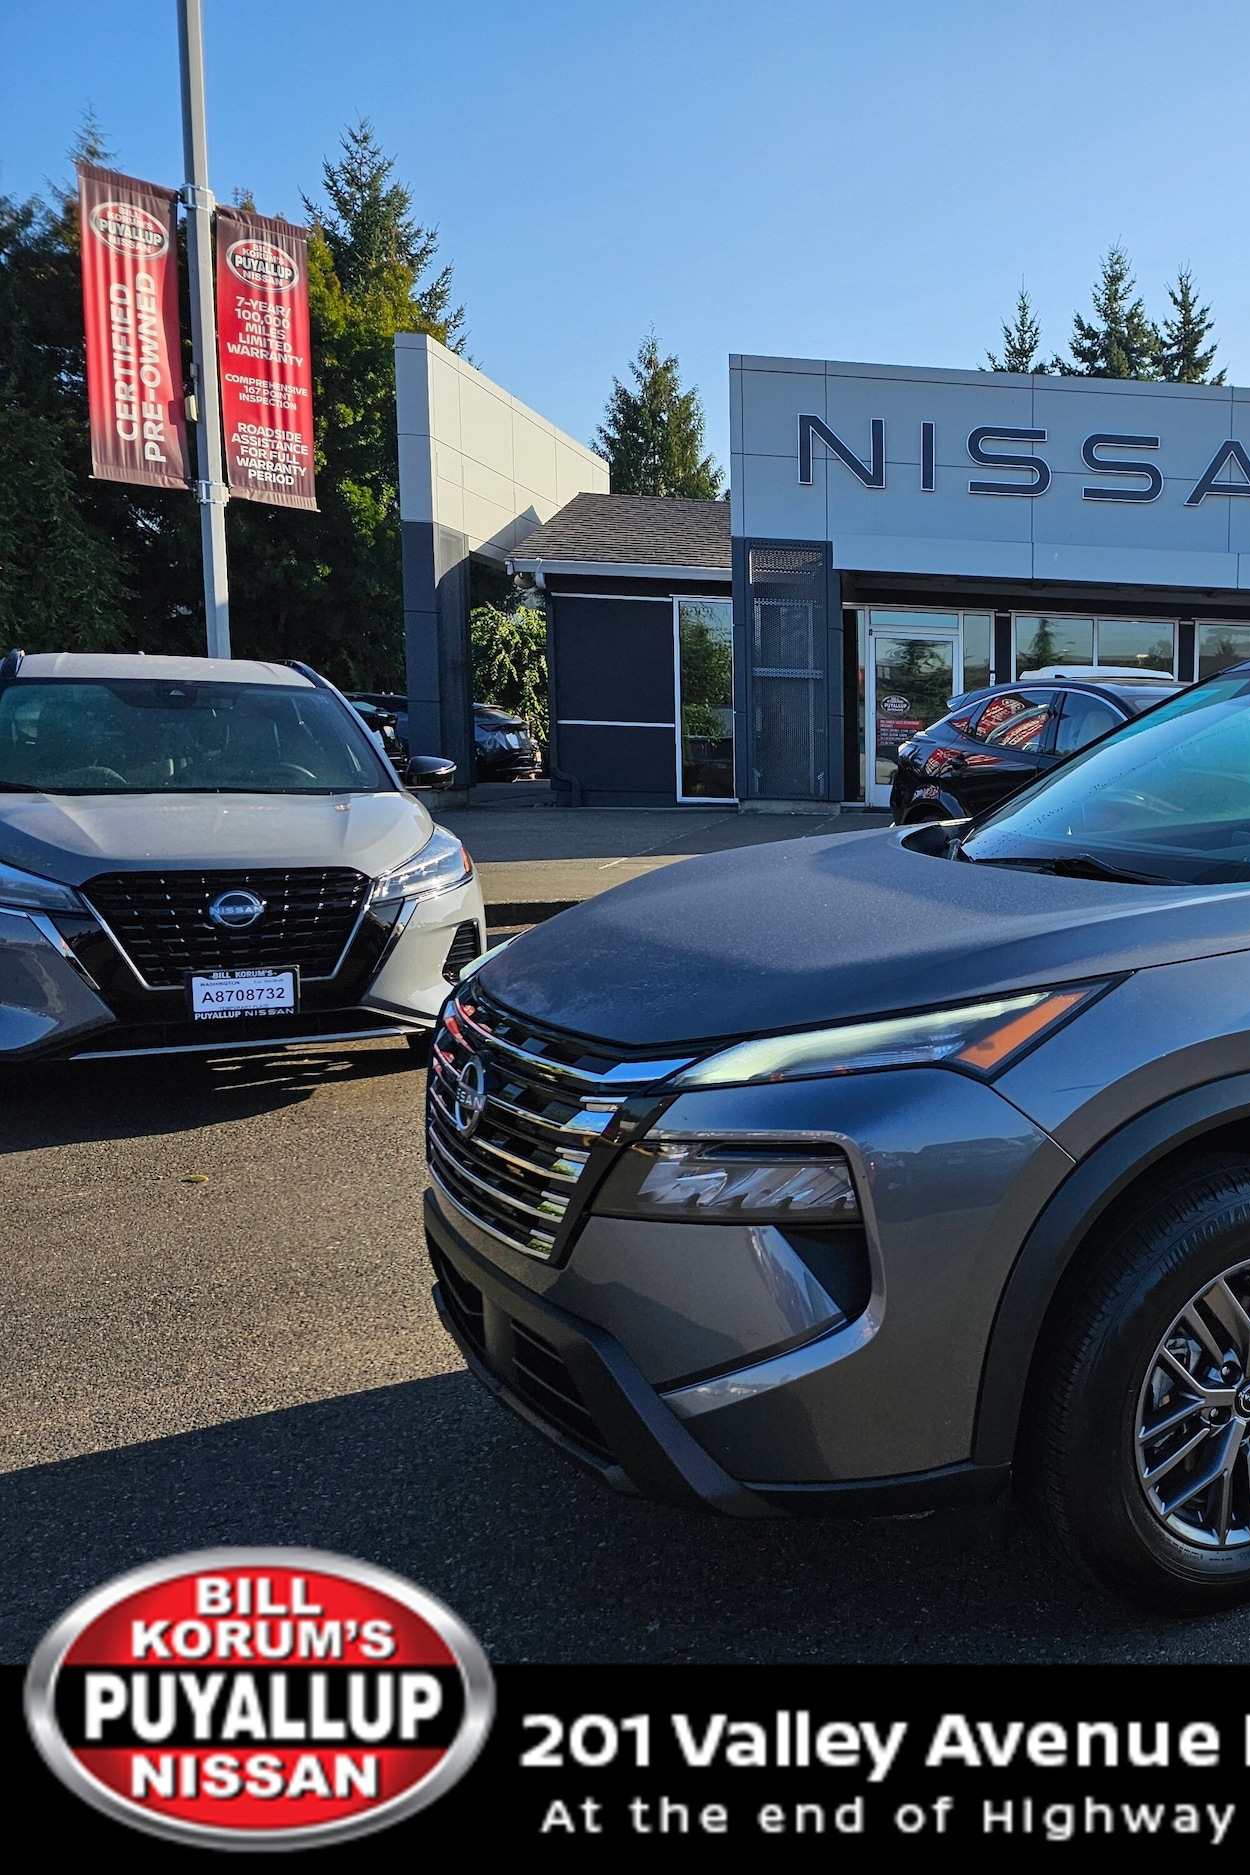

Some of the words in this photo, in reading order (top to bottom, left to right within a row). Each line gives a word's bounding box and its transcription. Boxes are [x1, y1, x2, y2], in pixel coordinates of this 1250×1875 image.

[107, 211, 154, 230] KORUM'S
[119, 206, 142, 220] BILL
[100, 218, 162, 246] PUYALLUP
[108, 235, 151, 253] NISSAN
[252, 243, 273, 255] BILL
[243, 248, 285, 265] KORUM'S
[235, 255, 292, 279] PUYALLUP
[243, 271, 283, 287] NISSAN
[236, 296, 291, 318] 7-YEAR/
[235, 308, 290, 329] 100,000
[245, 322, 286, 340] MILES
[239, 332, 292, 353] LIMITED
[110, 283, 138, 441] CERTIFIED
[227, 342, 304, 367] WARRANTY
[136, 272, 167, 462] PRE-OWNED
[225, 373, 308, 397] COMPREHENSIVE
[244, 385, 261, 395] 167
[263, 388, 292, 401] POINT
[239, 392, 297, 411] INSPECTION
[237, 422, 302, 443] ROADSIDE
[231, 433, 309, 455] ASSISTANCE
[240, 445, 267, 459] FOR
[270, 450, 300, 465] FULL
[236, 455, 307, 476] WARRANTY
[248, 469, 295, 486] PERIOD
[210, 905, 263, 915] NISSAN
[235, 970, 273, 978] KORUM'S
[202, 987, 285, 1003] A8708732
[194, 1011, 241, 1020] PUYALLUP
[244, 1008, 294, 1017] NISSAN
